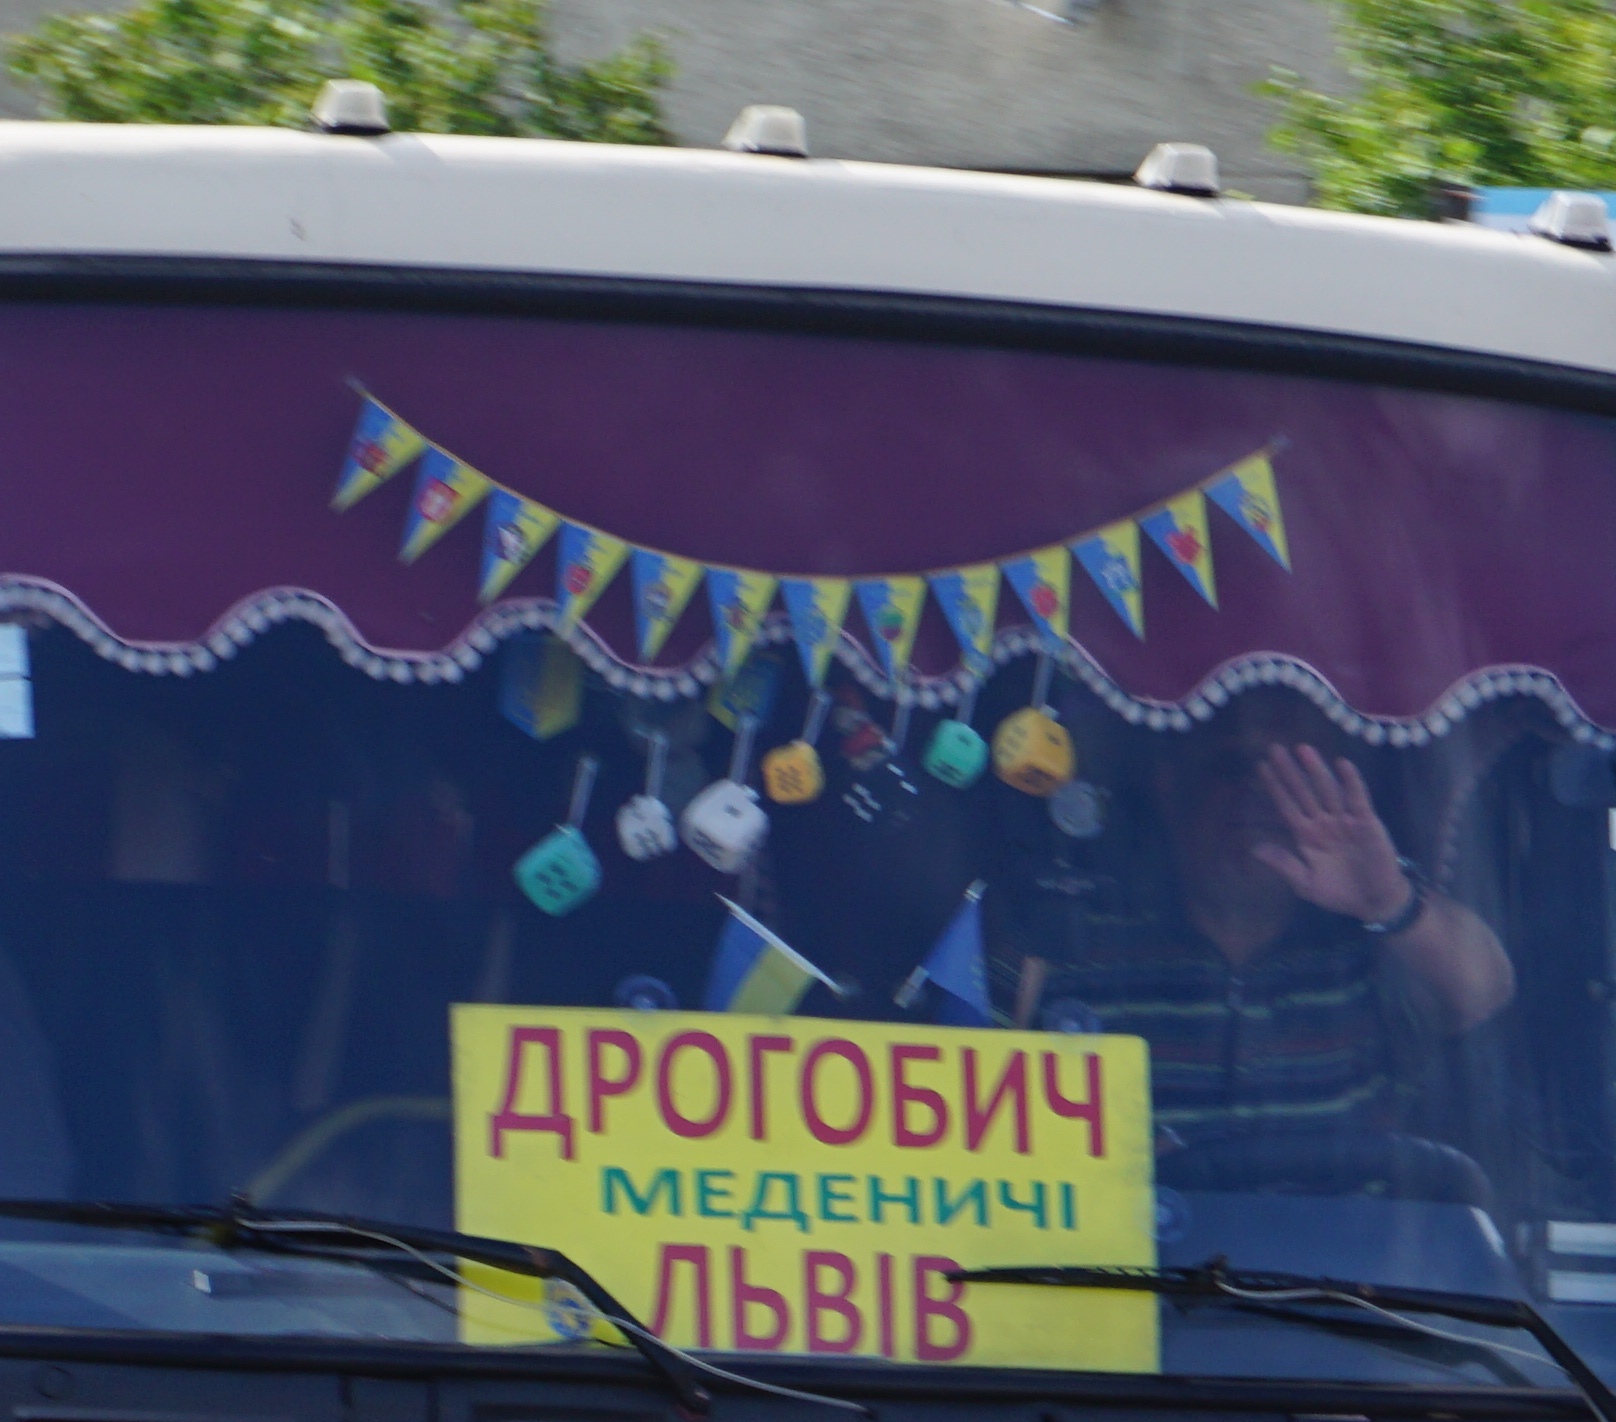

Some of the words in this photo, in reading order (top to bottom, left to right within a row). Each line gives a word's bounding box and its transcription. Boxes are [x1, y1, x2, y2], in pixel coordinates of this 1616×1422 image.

[486, 1024, 1110, 1161] ДРОГОБИЧ
[599, 1166, 1077, 1233] МЕДЕНИЧІ
[648, 1243, 974, 1363] ЛЬВІВ
